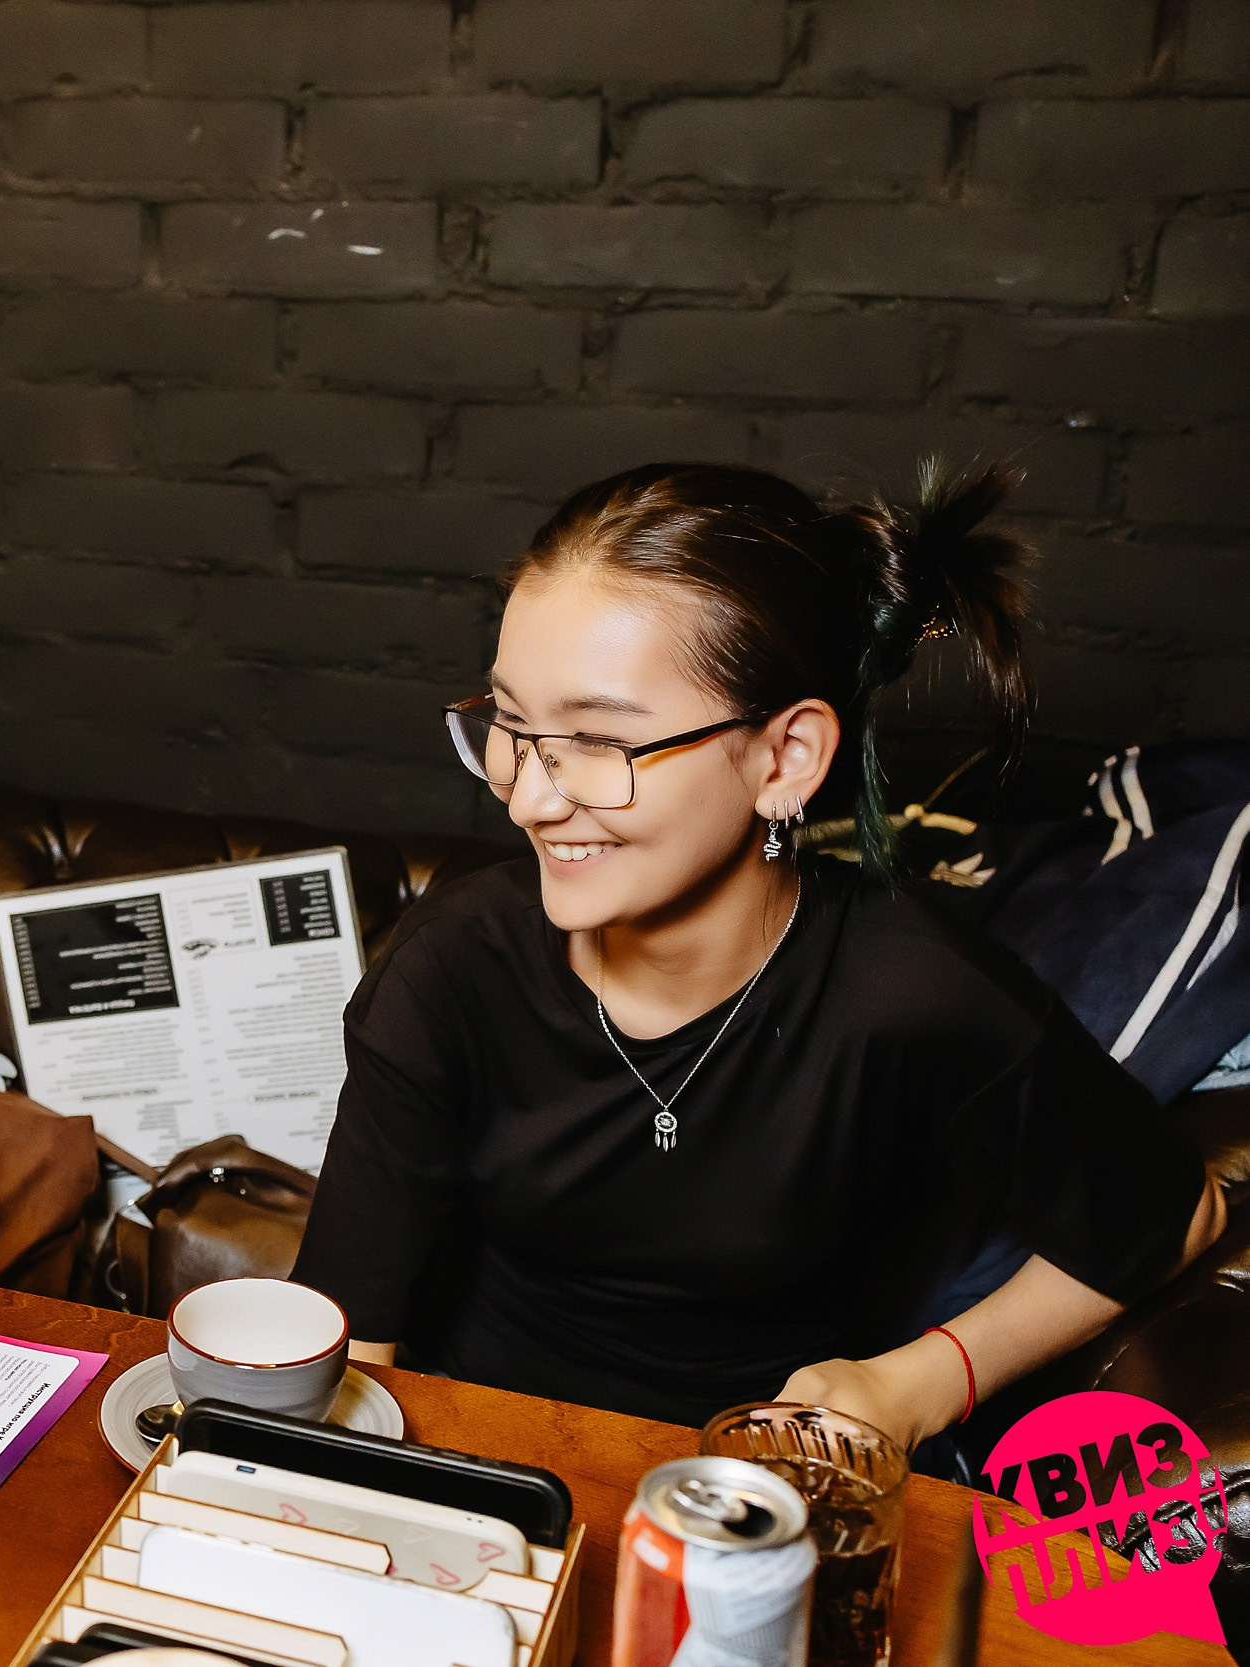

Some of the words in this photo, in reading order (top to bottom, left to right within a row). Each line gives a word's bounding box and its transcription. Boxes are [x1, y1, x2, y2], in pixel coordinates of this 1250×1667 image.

[18, 1382, 51, 1415] Инструкция
[11, 1414, 21, 1423] по
[0, 1422, 14, 1436] игре
